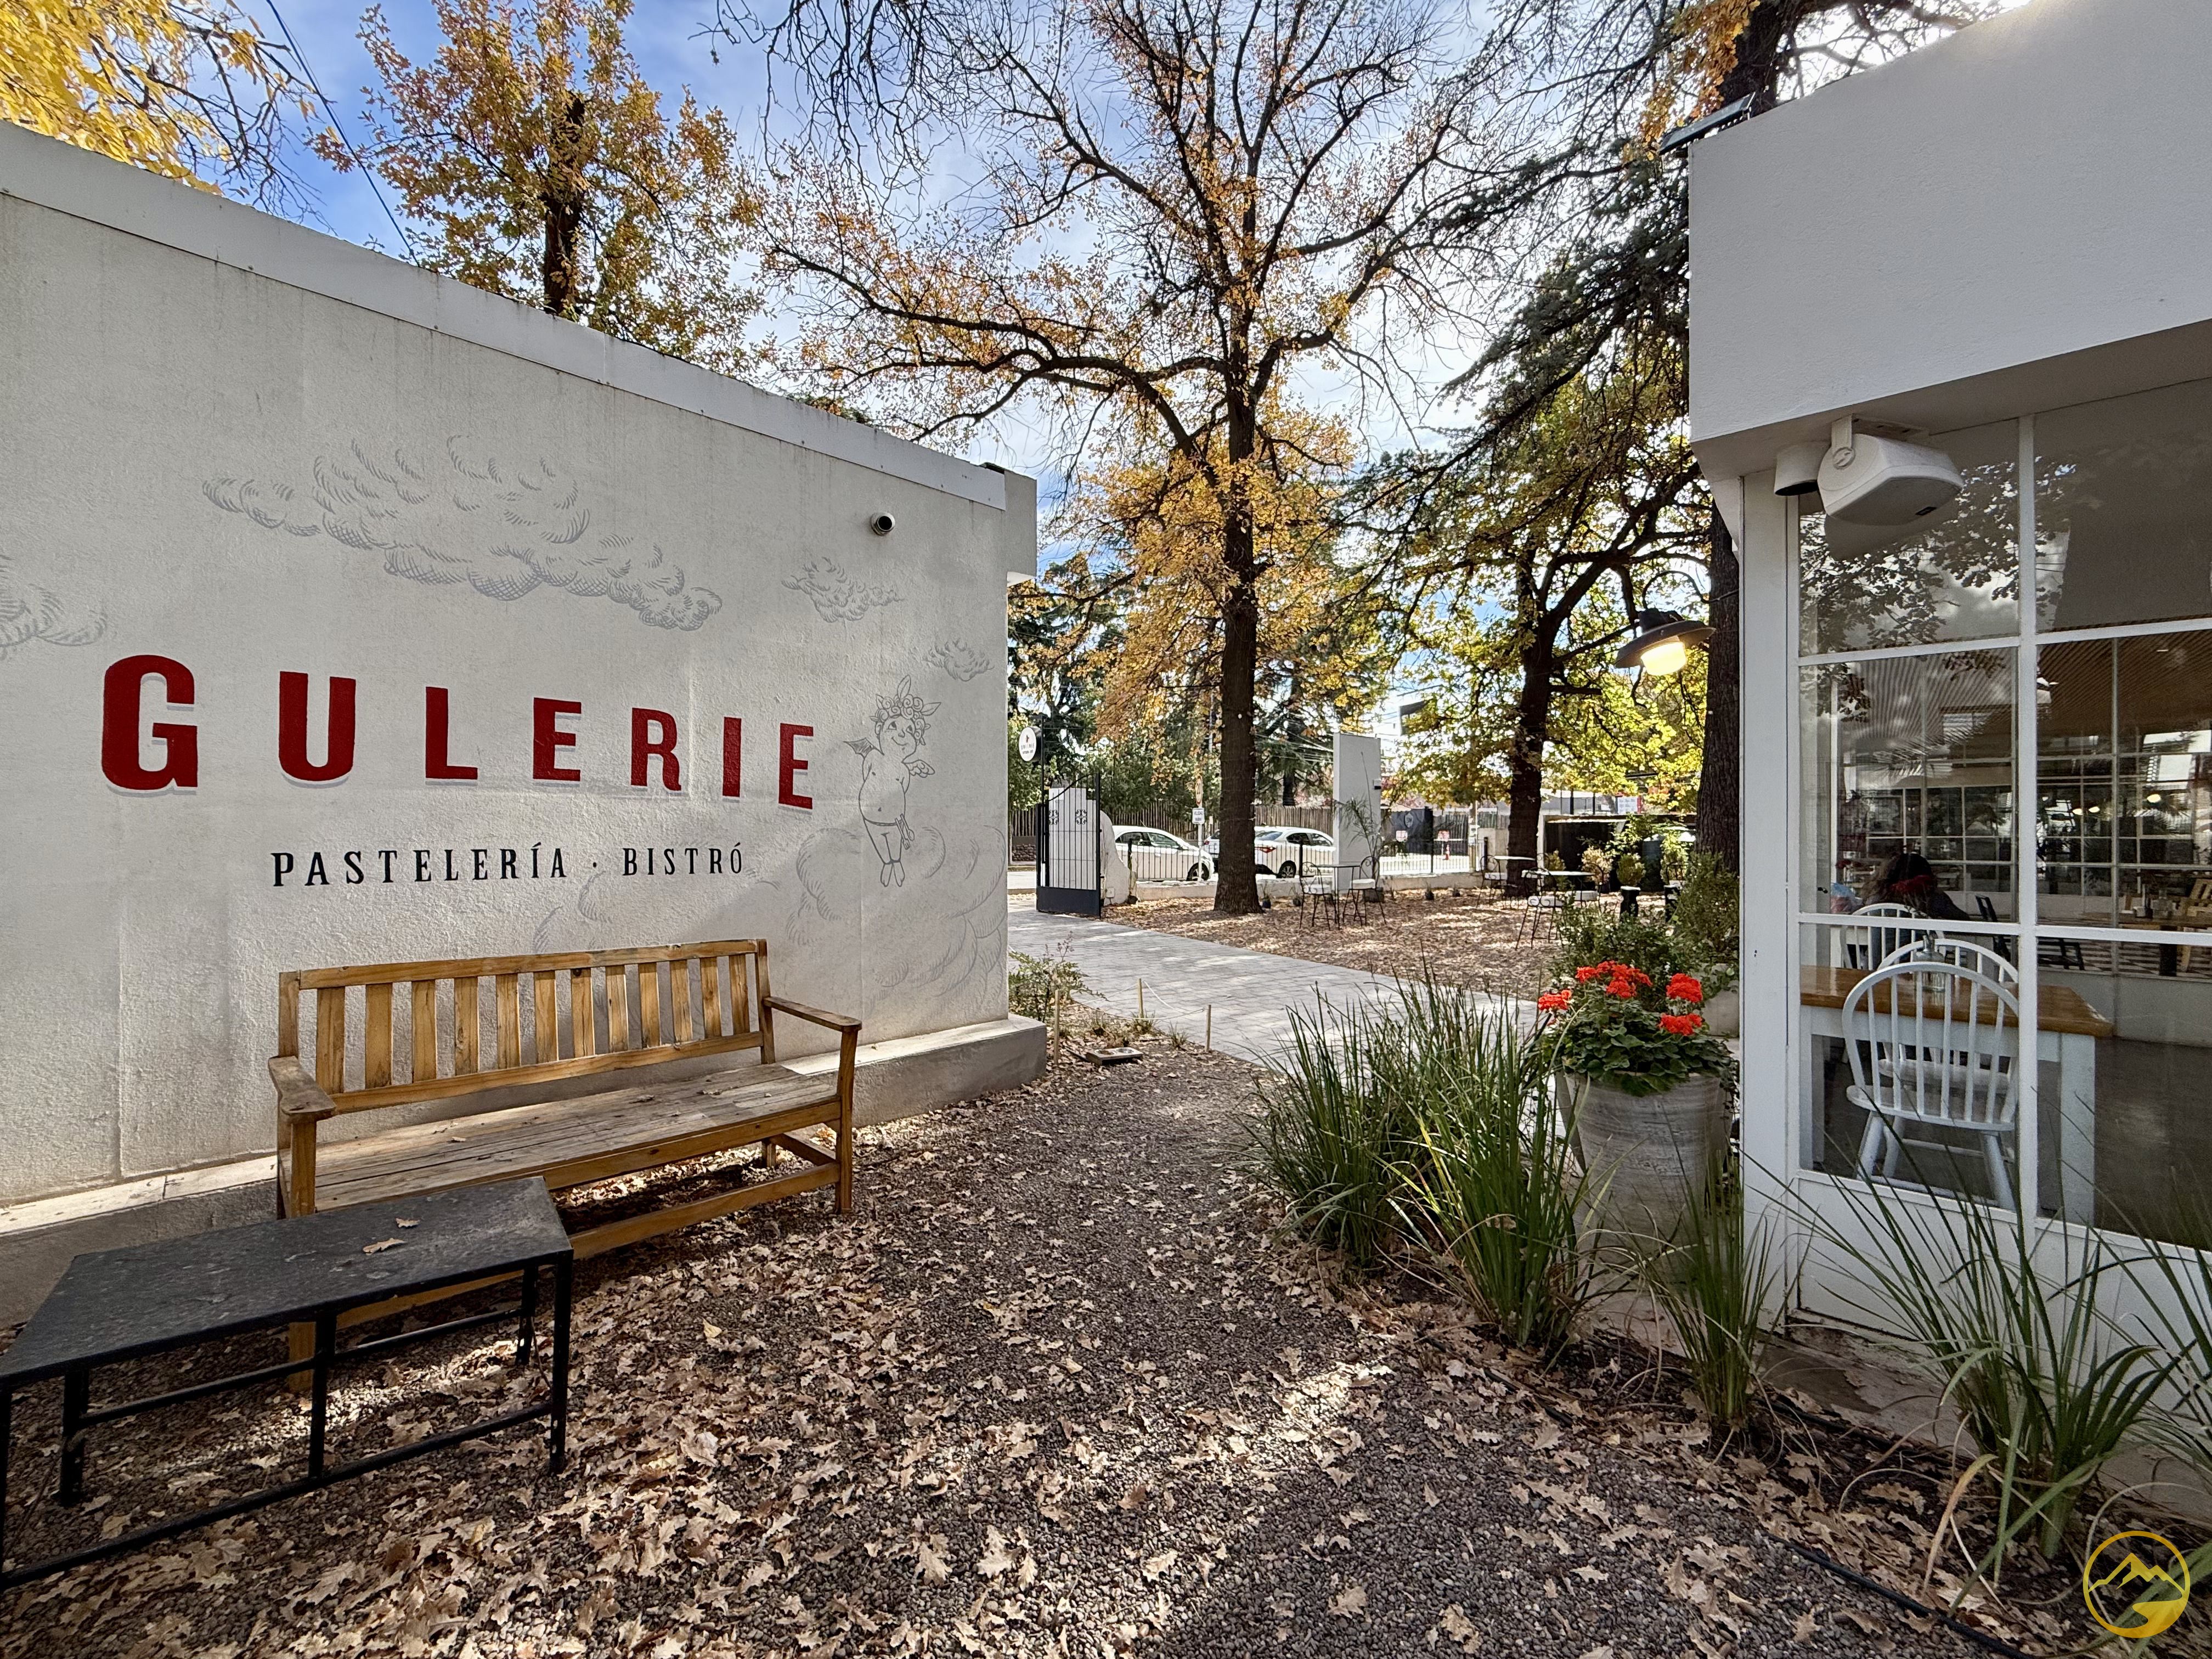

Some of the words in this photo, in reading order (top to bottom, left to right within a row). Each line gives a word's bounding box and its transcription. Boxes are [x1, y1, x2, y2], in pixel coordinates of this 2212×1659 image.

[102, 656, 814, 810] GULERIE
[270, 842, 567, 887] PASTELERÍA
[622, 842, 742, 876] BISTRÓ
